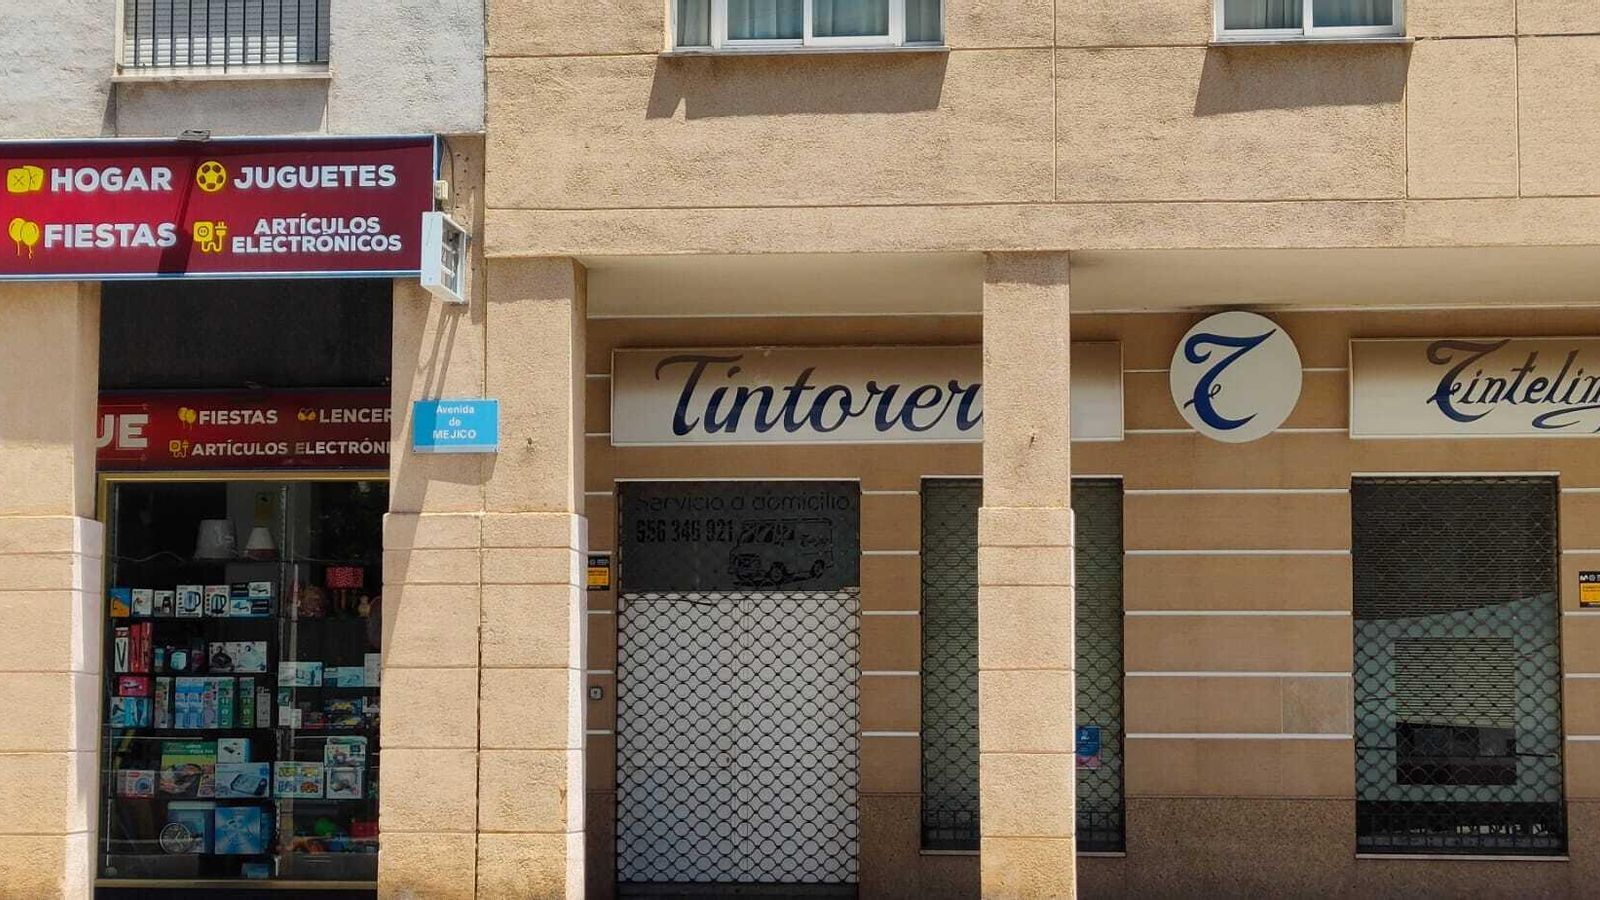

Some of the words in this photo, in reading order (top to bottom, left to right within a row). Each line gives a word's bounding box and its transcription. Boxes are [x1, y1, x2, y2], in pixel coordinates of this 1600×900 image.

[51, 167, 173, 192] HOGAR
[233, 164, 397, 189] JUGUETES
[253, 212, 381, 235] ARTÍCULOS
[44, 222, 177, 249] FIESTAS
[231, 231, 402, 253] ELECTRÓNICOS
[199, 408, 279, 425] FIESTAS
[436, 404, 475, 414] Avenida
[448, 416, 461, 427] de
[432, 429, 477, 439] MEJICO
[191, 439, 289, 456] ARTÍCULOS
